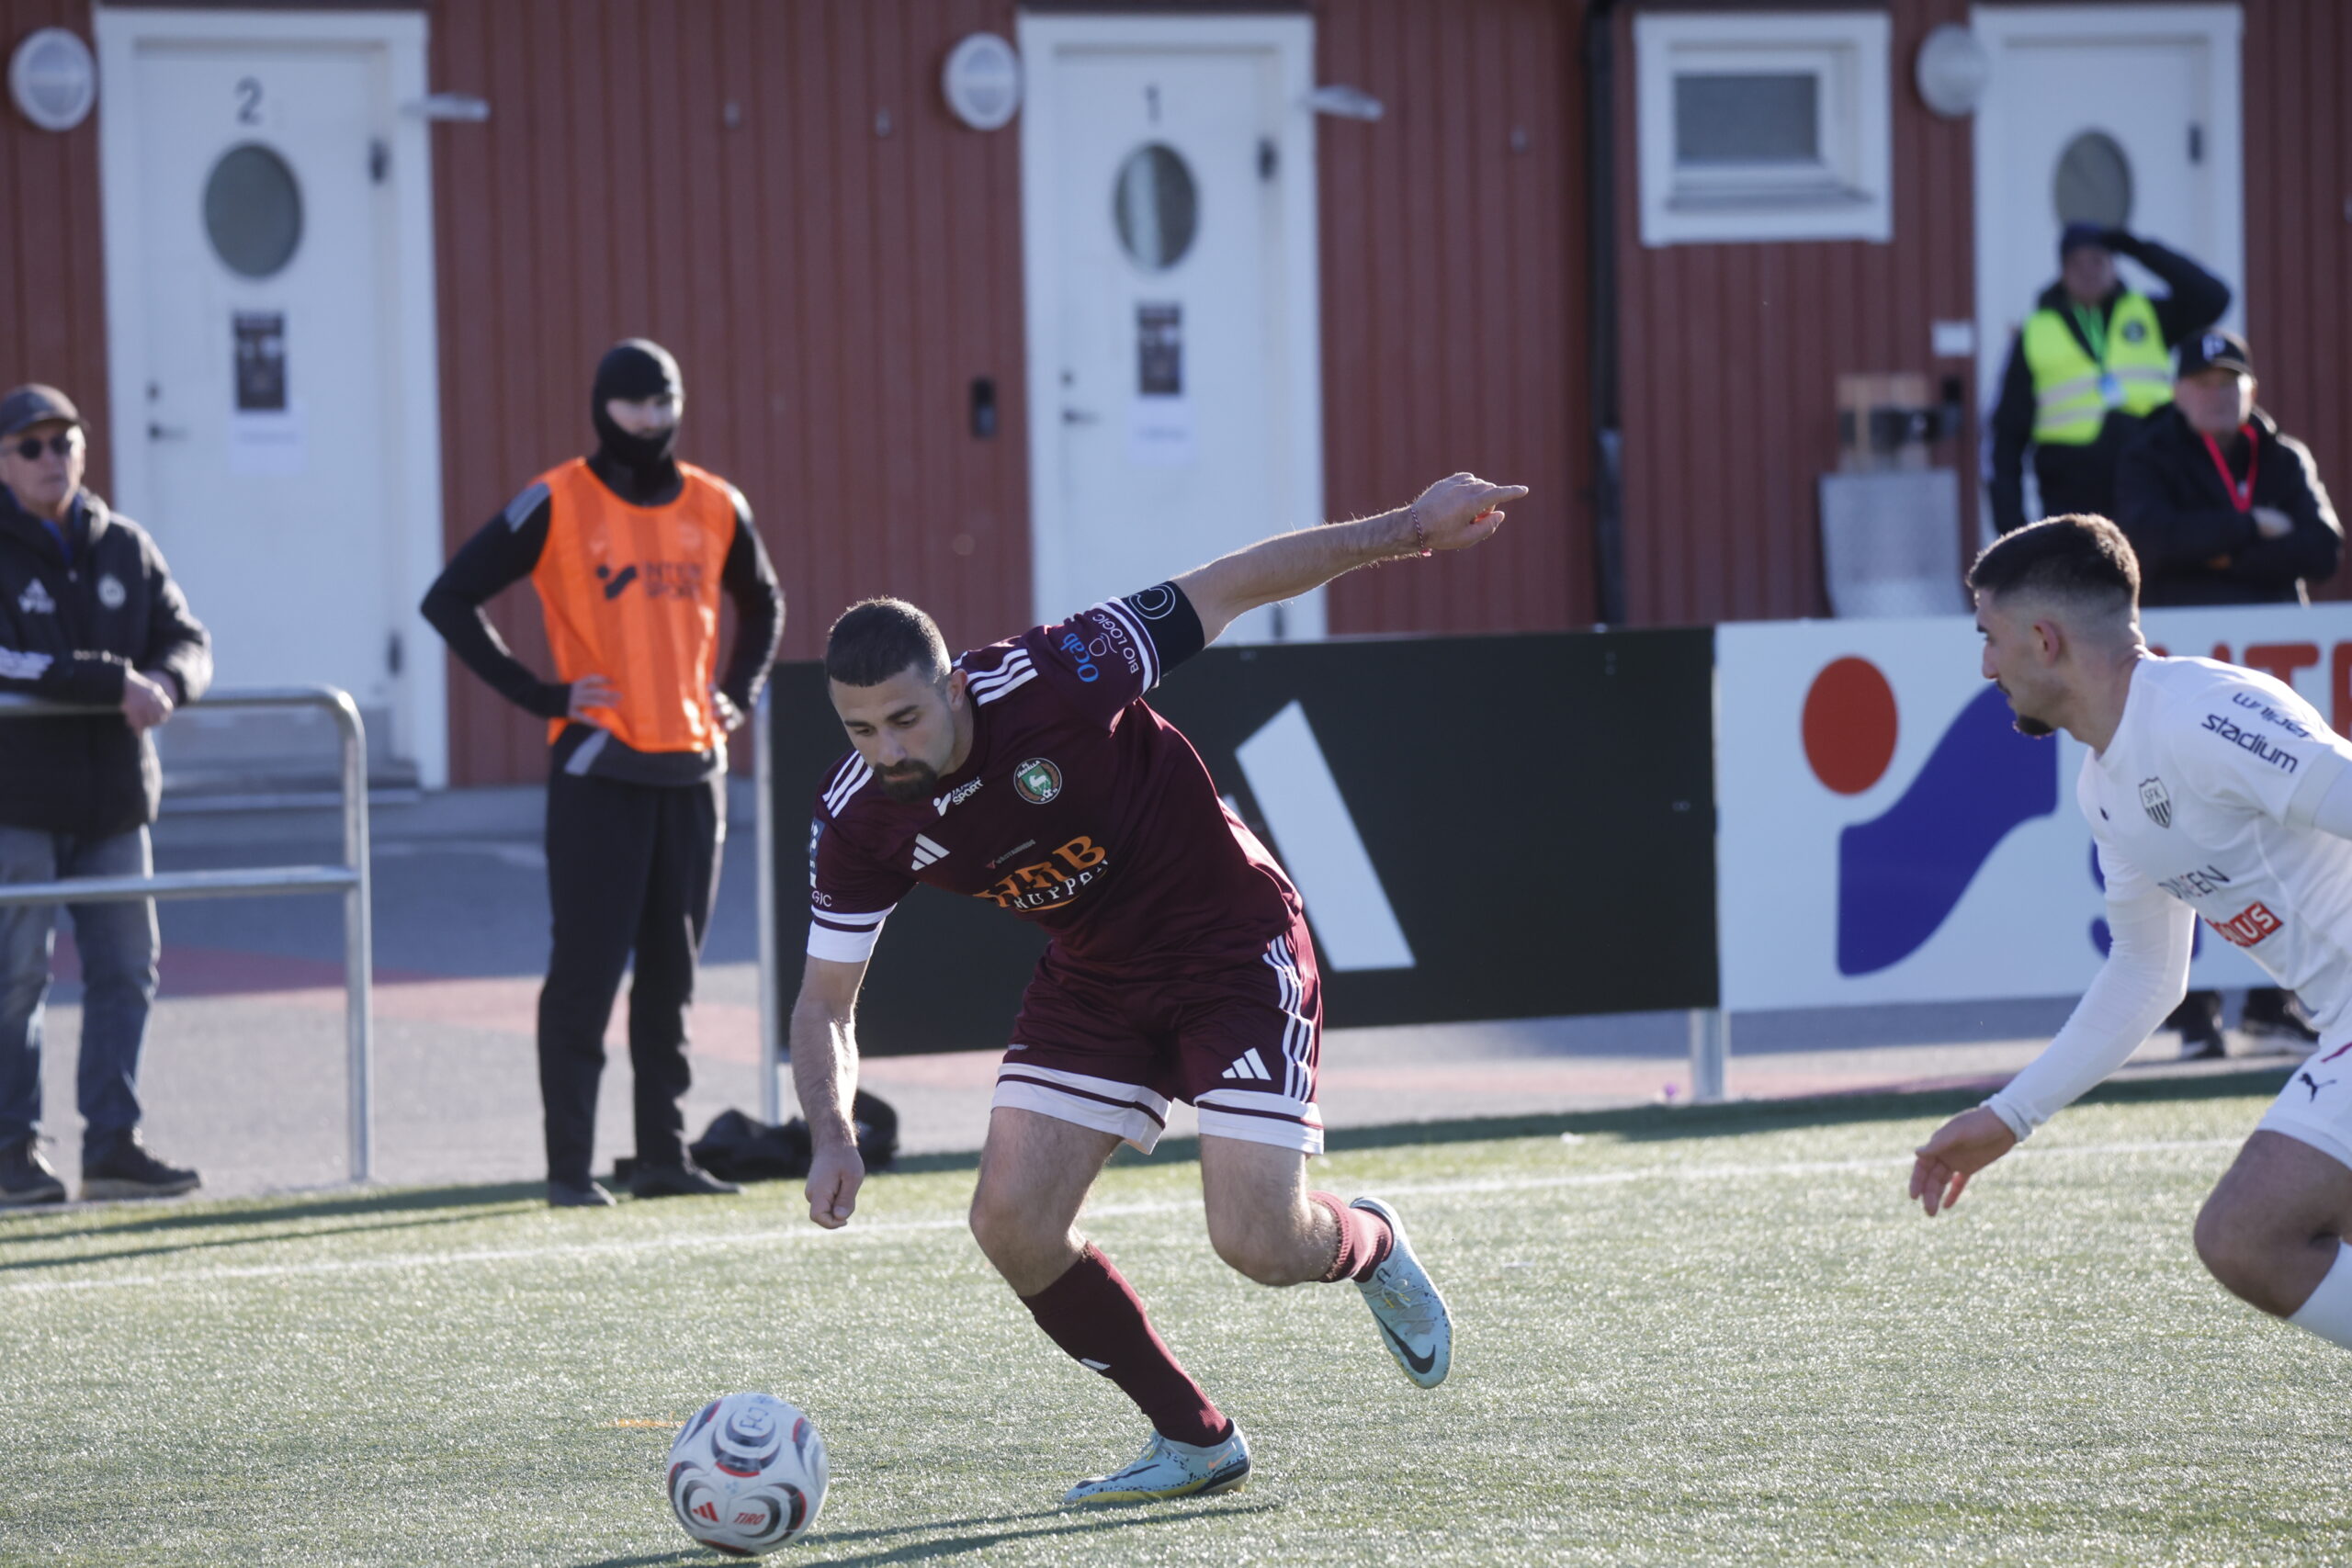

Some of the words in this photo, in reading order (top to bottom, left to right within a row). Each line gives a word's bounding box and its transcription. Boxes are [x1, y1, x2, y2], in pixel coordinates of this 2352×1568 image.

[235, 76, 263, 126] 2
[1145, 84, 1162, 124] 1
[1091, 613, 1128, 645] LOGIC
[1059, 632, 1099, 682] Ocab
[1123, 647, 1139, 674] BIO
[2201, 713, 2299, 773] stadium
[952, 780, 984, 805] SPORT
[733, 1512, 767, 1526] TIRO
